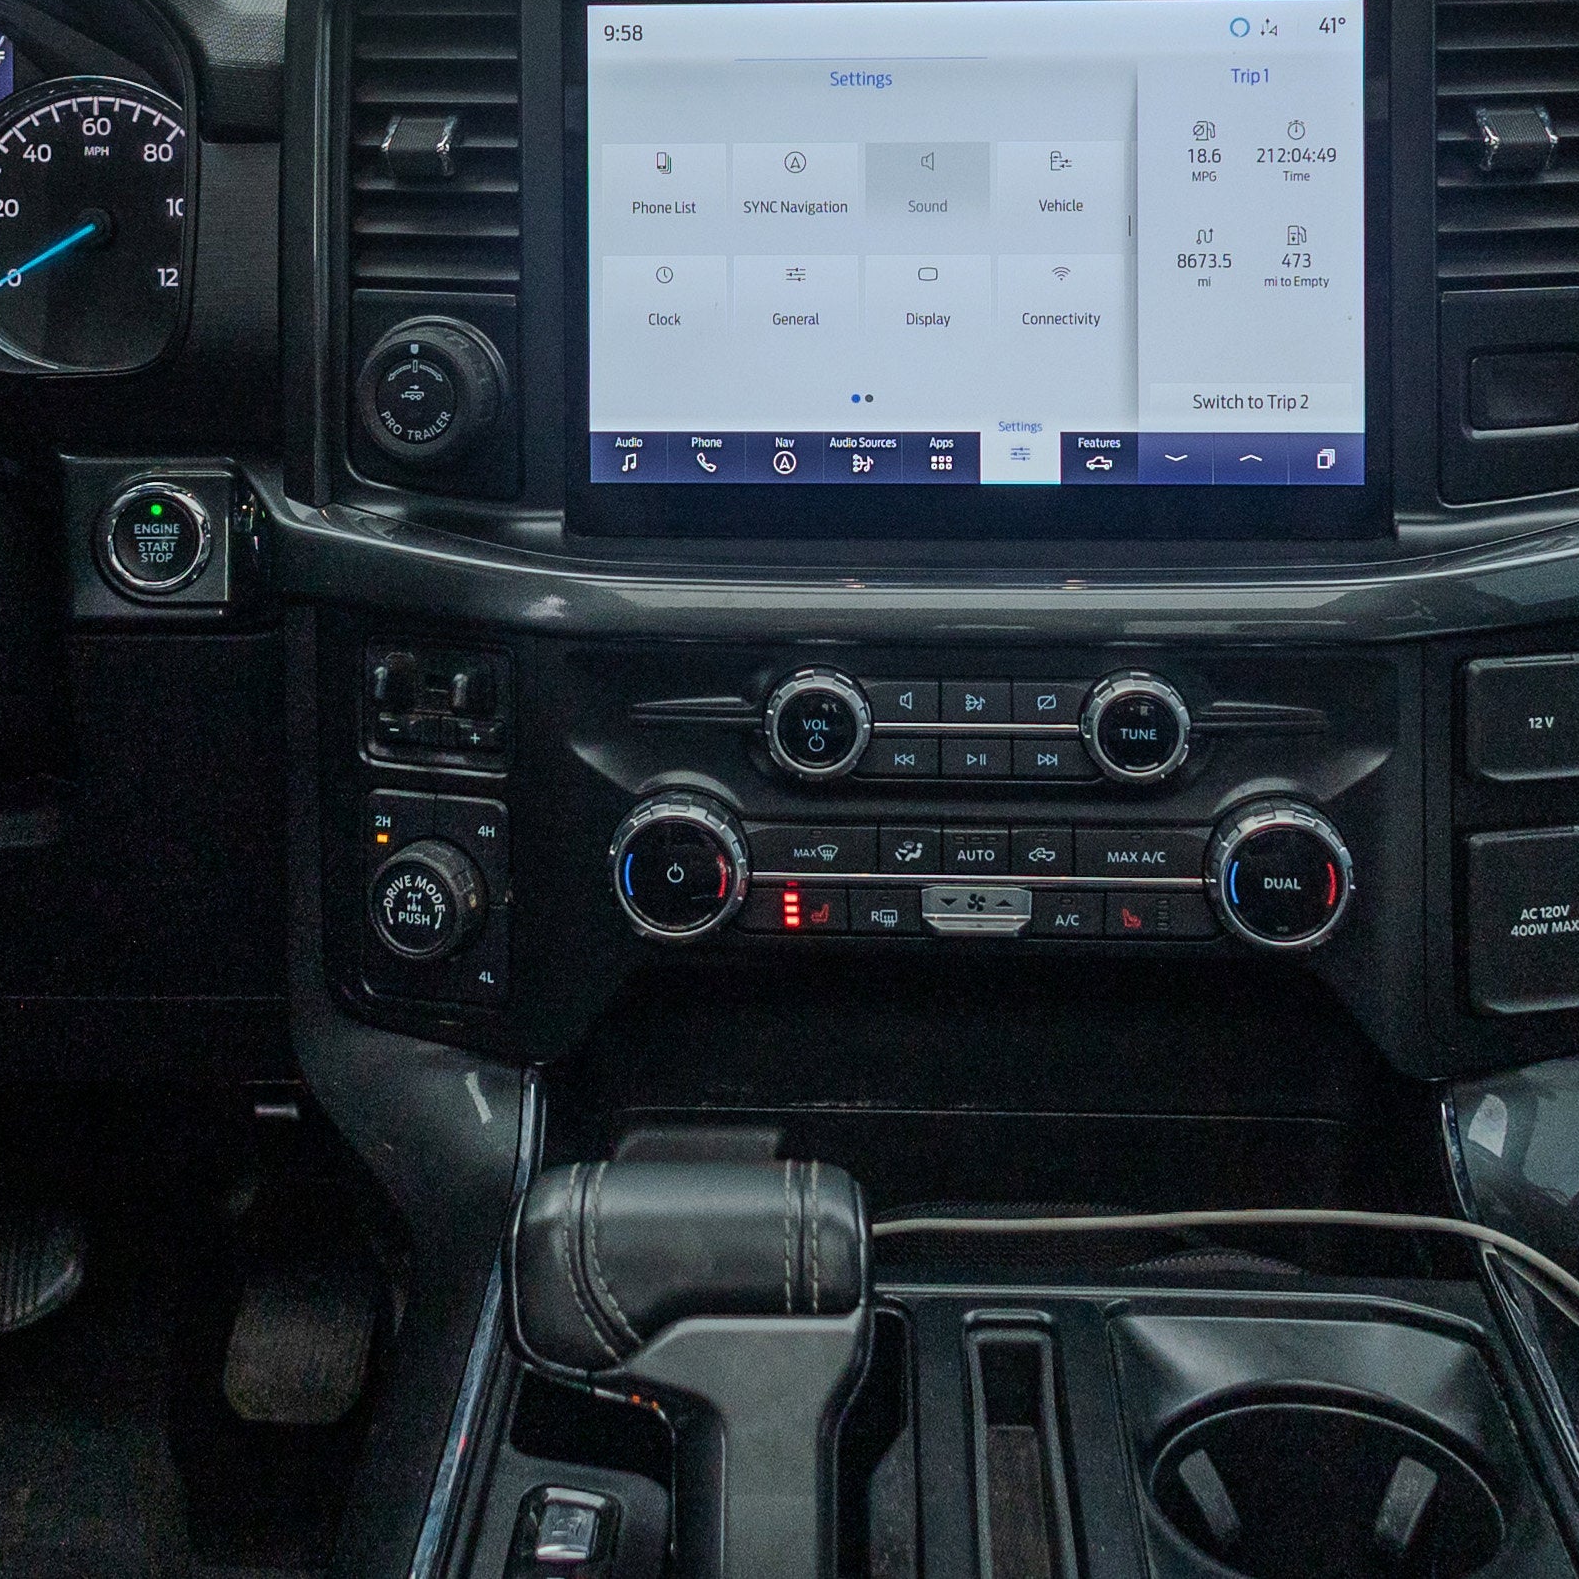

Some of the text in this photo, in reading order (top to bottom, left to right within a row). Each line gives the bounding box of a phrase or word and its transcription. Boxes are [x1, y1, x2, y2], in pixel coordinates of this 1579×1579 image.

[1318, 16, 1347, 34] 41°
[604, 24, 643, 42] 9:58
[829, 71, 893, 89] Settings
[1231, 68, 1270, 86] Trip 1
[81, 117, 112, 136] 60
[22, 143, 53, 163] 40
[83, 145, 110, 157] MPH
[143, 143, 173, 163] 80
[1187, 148, 1222, 164] 18.6
[1256, 147, 1337, 164] 212:04:49
[1191, 171, 1217, 182] MPG
[1283, 170, 1311, 182] Time
[632, 201, 697, 214] Phone List
[743, 200, 849, 216] SYNC Navigation
[907, 199, 948, 213] Sound
[1038, 199, 1084, 212] Vehicle
[1177, 253, 1232, 269] 8673.5
[1281, 253, 1311, 268] 473
[1197, 277, 1212, 288] mi
[1264, 276, 1330, 289] mi to Empty
[648, 312, 682, 326] Clock
[772, 312, 820, 326] General
[905, 312, 951, 328] Display
[1022, 312, 1101, 328] Connectivity
[1192, 394, 1310, 412] Switch to Trip 2
[380, 410, 452, 442] PRO TRAILER
[998, 420, 1043, 433] Settings
[615, 436, 644, 449] Audio
[691, 436, 723, 449] Phone
[775, 436, 795, 449] Nav
[829, 436, 897, 449] Audio Sources
[929, 436, 955, 450] Apps
[1078, 436, 1122, 449] Features
[133, 523, 181, 535] ENGINE
[138, 541, 177, 553] START
[140, 552, 174, 564] STOP
[802, 719, 830, 731] VOL
[1528, 716, 1555, 729] 12 V
[1120, 727, 1158, 740] TUNE
[374, 815, 392, 828] 2H
[477, 825, 496, 838] 4H
[793, 848, 817, 858] MAX
[957, 849, 995, 862] AUTO
[1107, 851, 1167, 864] MAX A/C
[1263, 877, 1302, 890] DUAL
[383, 874, 447, 913] DRIVE MODE
[397, 911, 431, 926] PUSH
[1520, 904, 1570, 921] AC 120V
[1055, 914, 1080, 927] A/C
[1510, 922, 1549, 937] 400W
[478, 971, 495, 984] 4L
